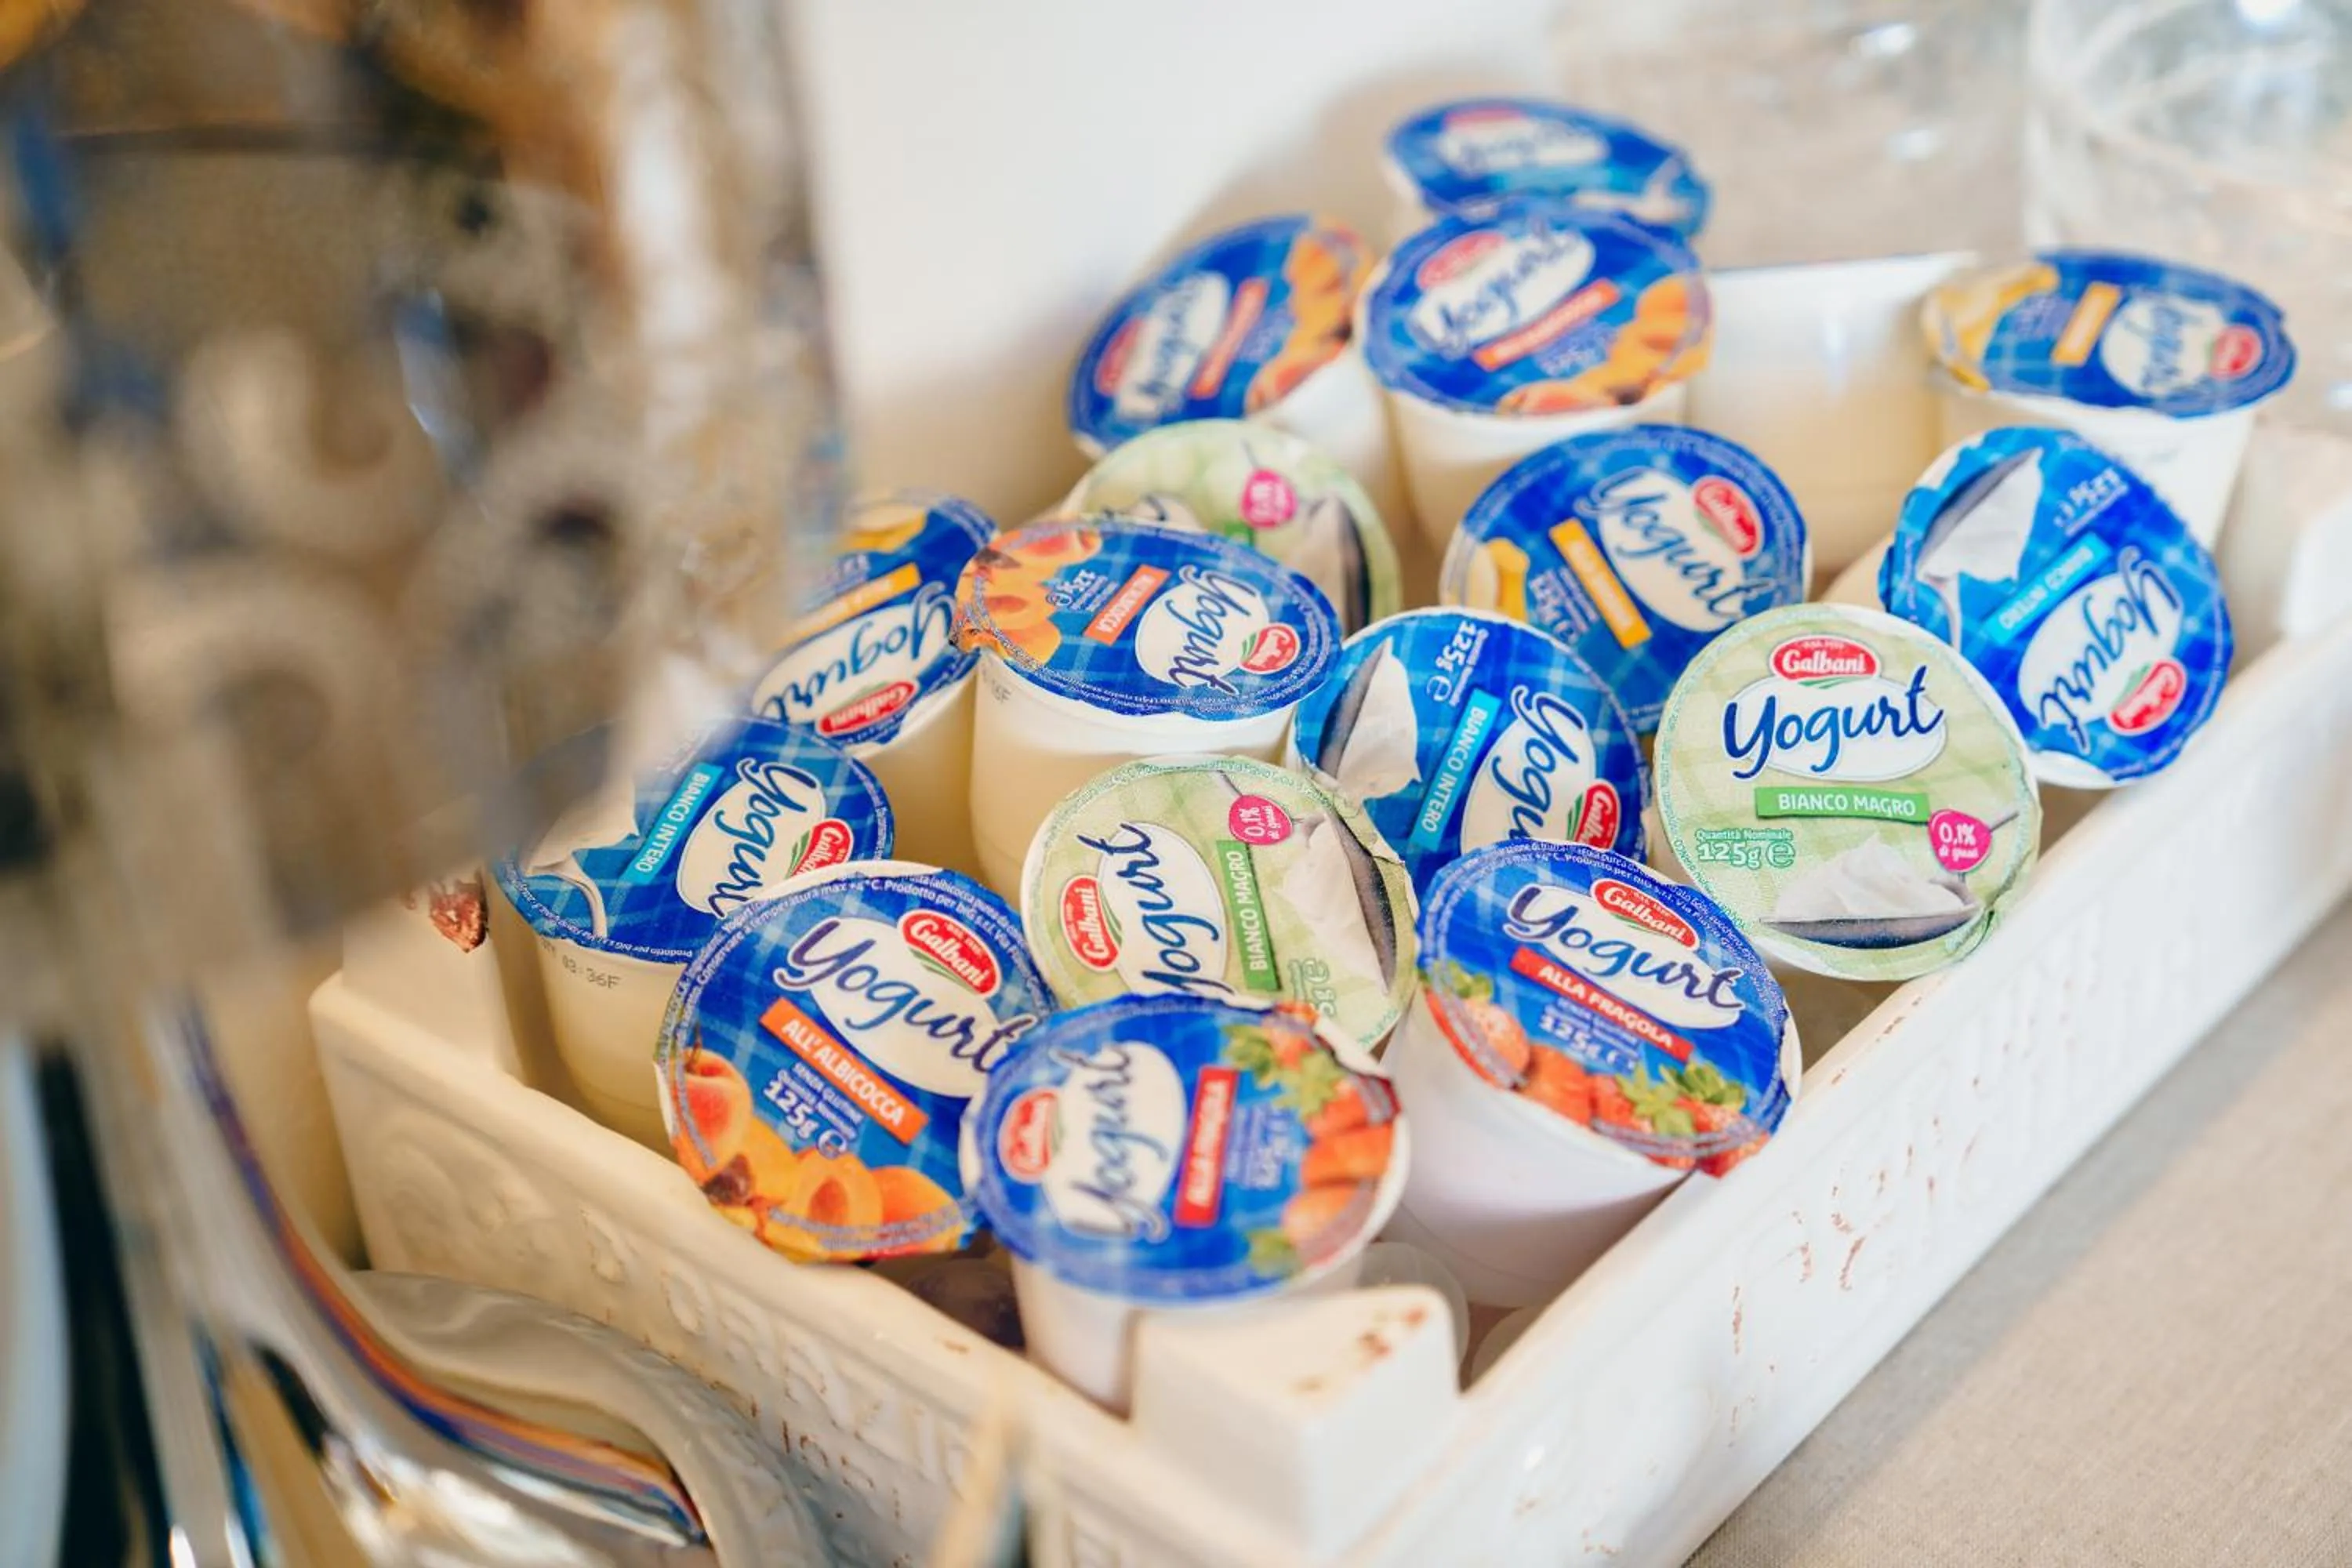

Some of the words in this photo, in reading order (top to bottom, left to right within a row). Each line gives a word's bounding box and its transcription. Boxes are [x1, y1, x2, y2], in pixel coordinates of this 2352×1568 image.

[1573, 466, 1777, 624] Yogurt
[1167, 564, 1254, 696] Yogurt
[1436, 622, 1477, 673] 125g
[2038, 544, 2184, 753] Yogurt
[1783, 650, 1866, 676] Galbani
[1455, 706, 1488, 771] BIANCO
[1724, 665, 1944, 779] Yogurt
[1492, 684, 1586, 840] Yogu
[666, 773, 710, 823] BIANCO
[1421, 772, 1454, 833] INTERO
[1581, 792, 1613, 845] Galb
[1778, 793, 1848, 812] BIANCO
[1853, 797, 1917, 817] MAGRO
[636, 821, 677, 873] INTERO
[800, 828, 838, 877] Galban
[1228, 850, 1253, 906] MAGRO
[1697, 841, 1761, 869] 125g
[884, 880, 937, 902] Prodotto
[934, 891, 957, 912] per
[1075, 887, 1111, 960] Galbani
[1604, 887, 1687, 939] Galbani
[913, 920, 992, 993] Galbani
[1239, 909, 1269, 971] BIANCO
[1503, 884, 1746, 1011] Yogurt
[774, 916, 1036, 1073] Yogurt
[1540, 966, 1585, 1000] ALLA
[1588, 989, 1675, 1048] FRAGOLA
[763, 1078, 817, 1141] 125g
[1050, 1040, 1171, 1244] Yogurt
